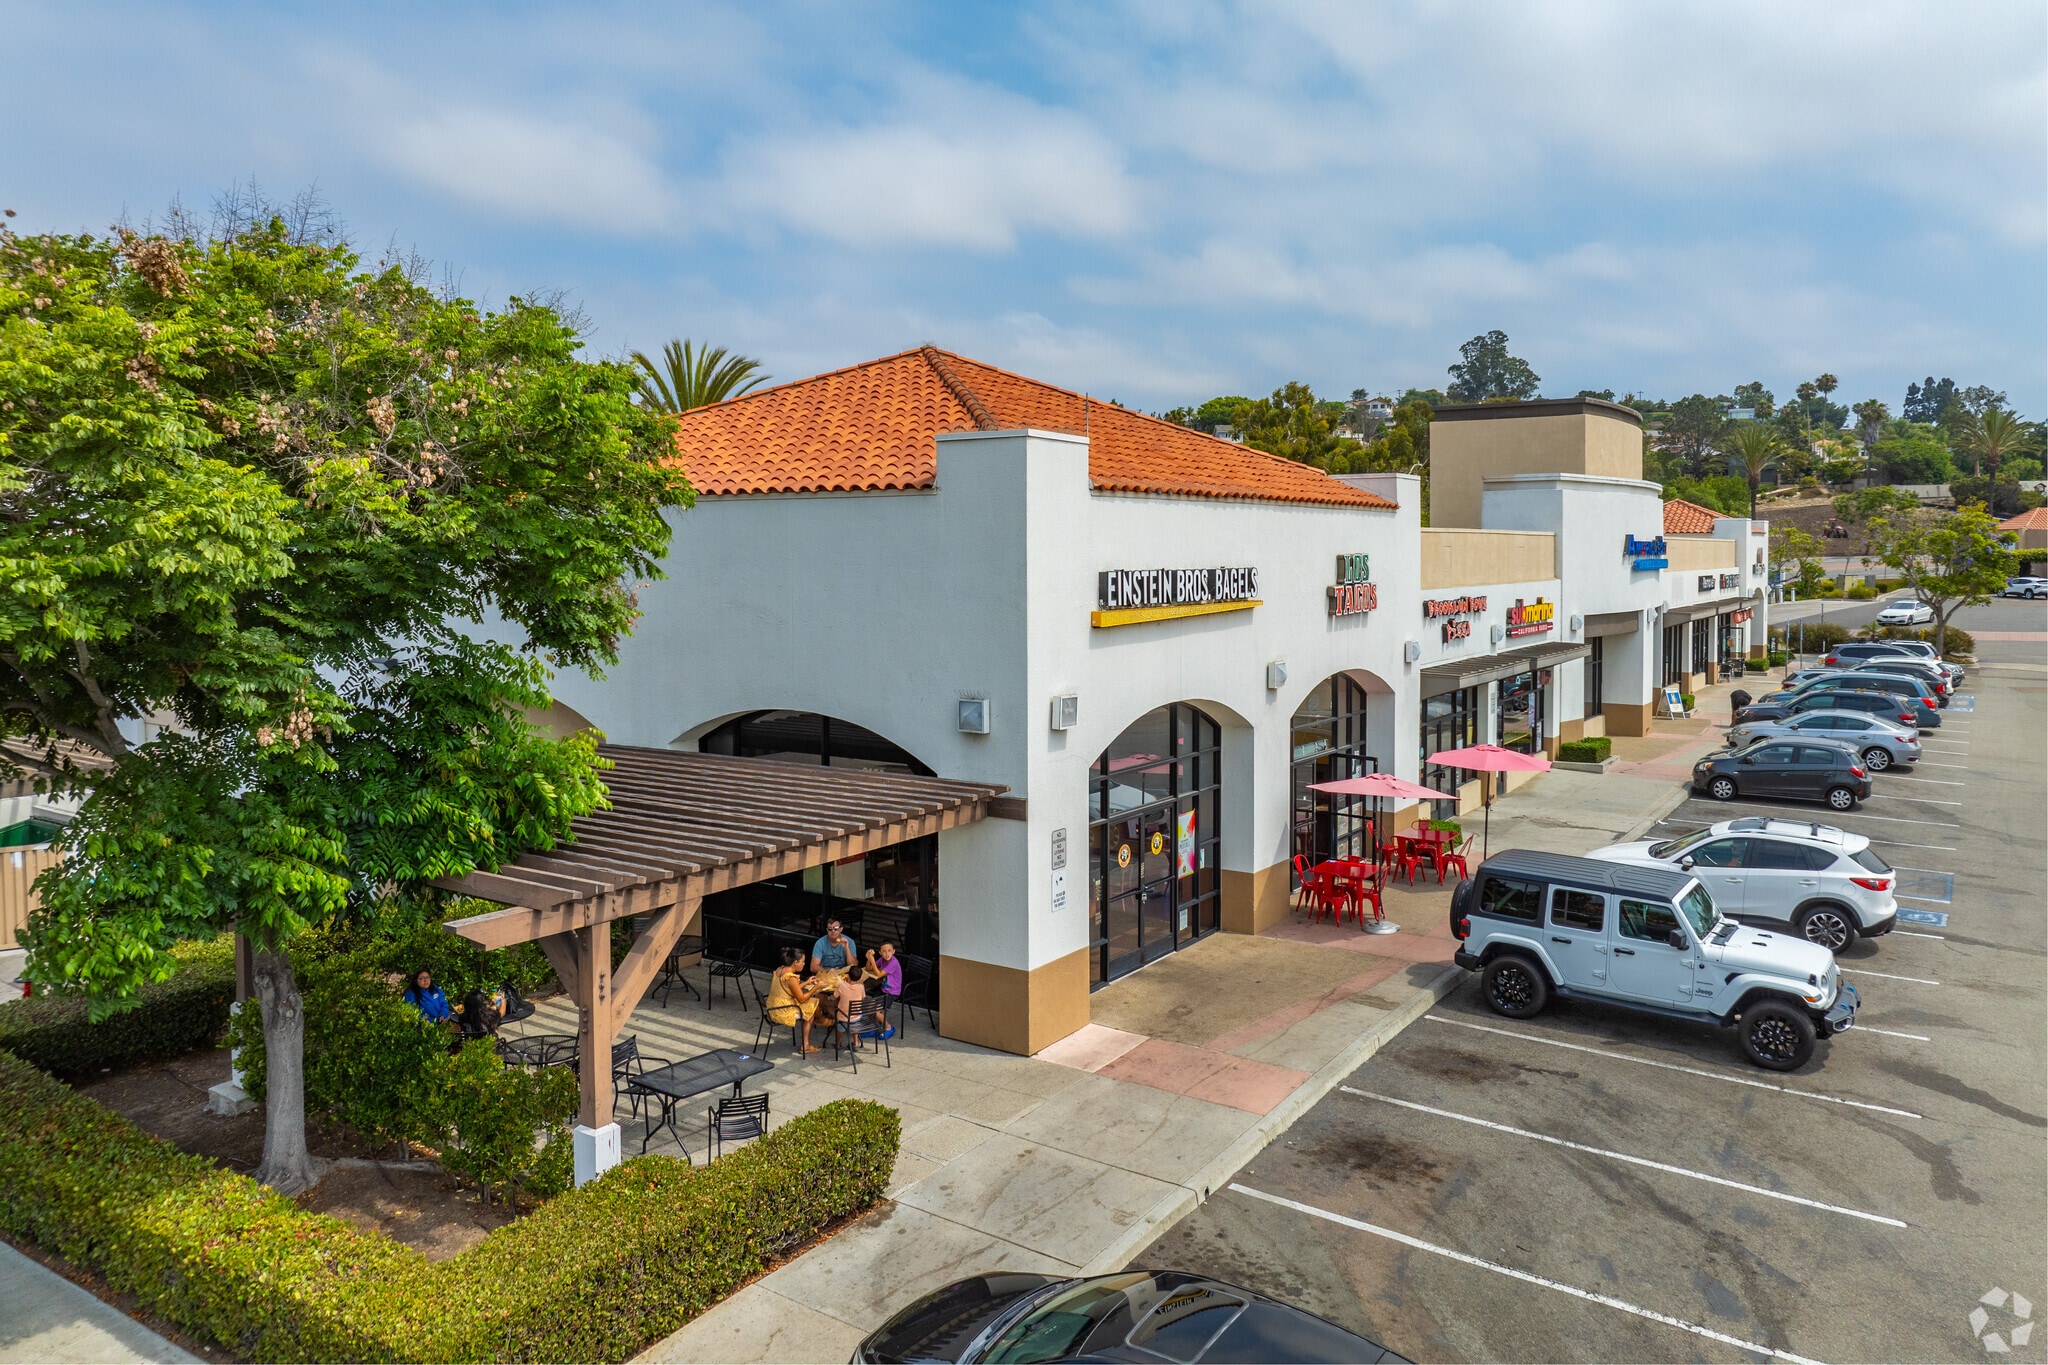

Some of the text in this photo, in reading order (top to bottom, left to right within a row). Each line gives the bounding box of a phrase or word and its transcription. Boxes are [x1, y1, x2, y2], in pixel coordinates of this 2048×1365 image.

[1344, 553, 1369, 583] LOS
[1107, 567, 1259, 606] EINSTEIN BROS. BAGELS
[1334, 583, 1377, 616] TACOS
[1511, 597, 1554, 624] submarina
[1517, 625, 1538, 635] CALIFORNIA
[1695, 987, 1713, 996] Jeep
